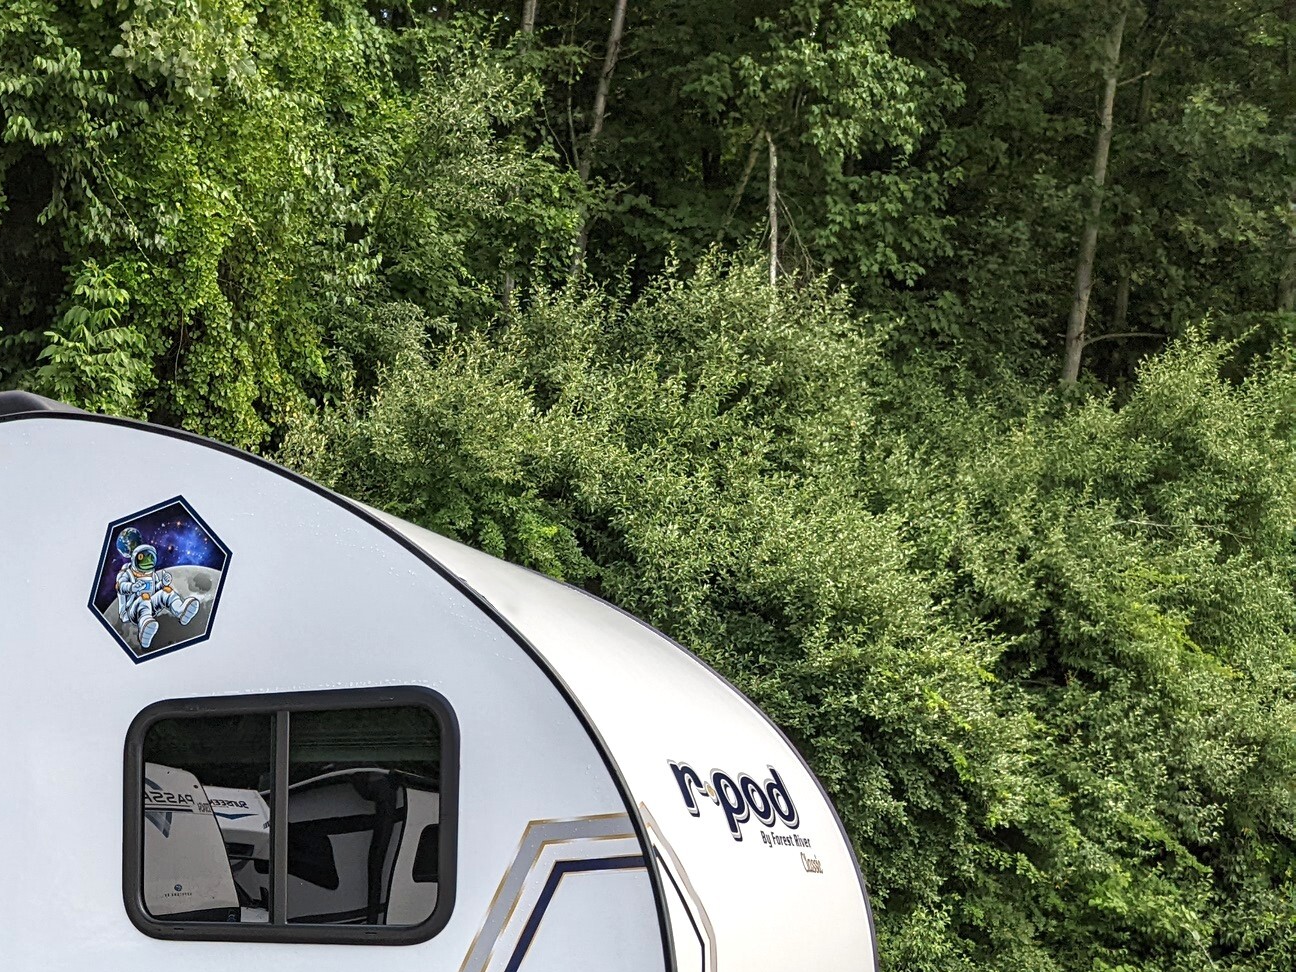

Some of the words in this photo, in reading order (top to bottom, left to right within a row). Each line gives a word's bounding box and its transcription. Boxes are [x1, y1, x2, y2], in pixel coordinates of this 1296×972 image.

[760, 830, 773, 848] By
[770, 831, 795, 847] Forest
[793, 834, 811, 848] River
